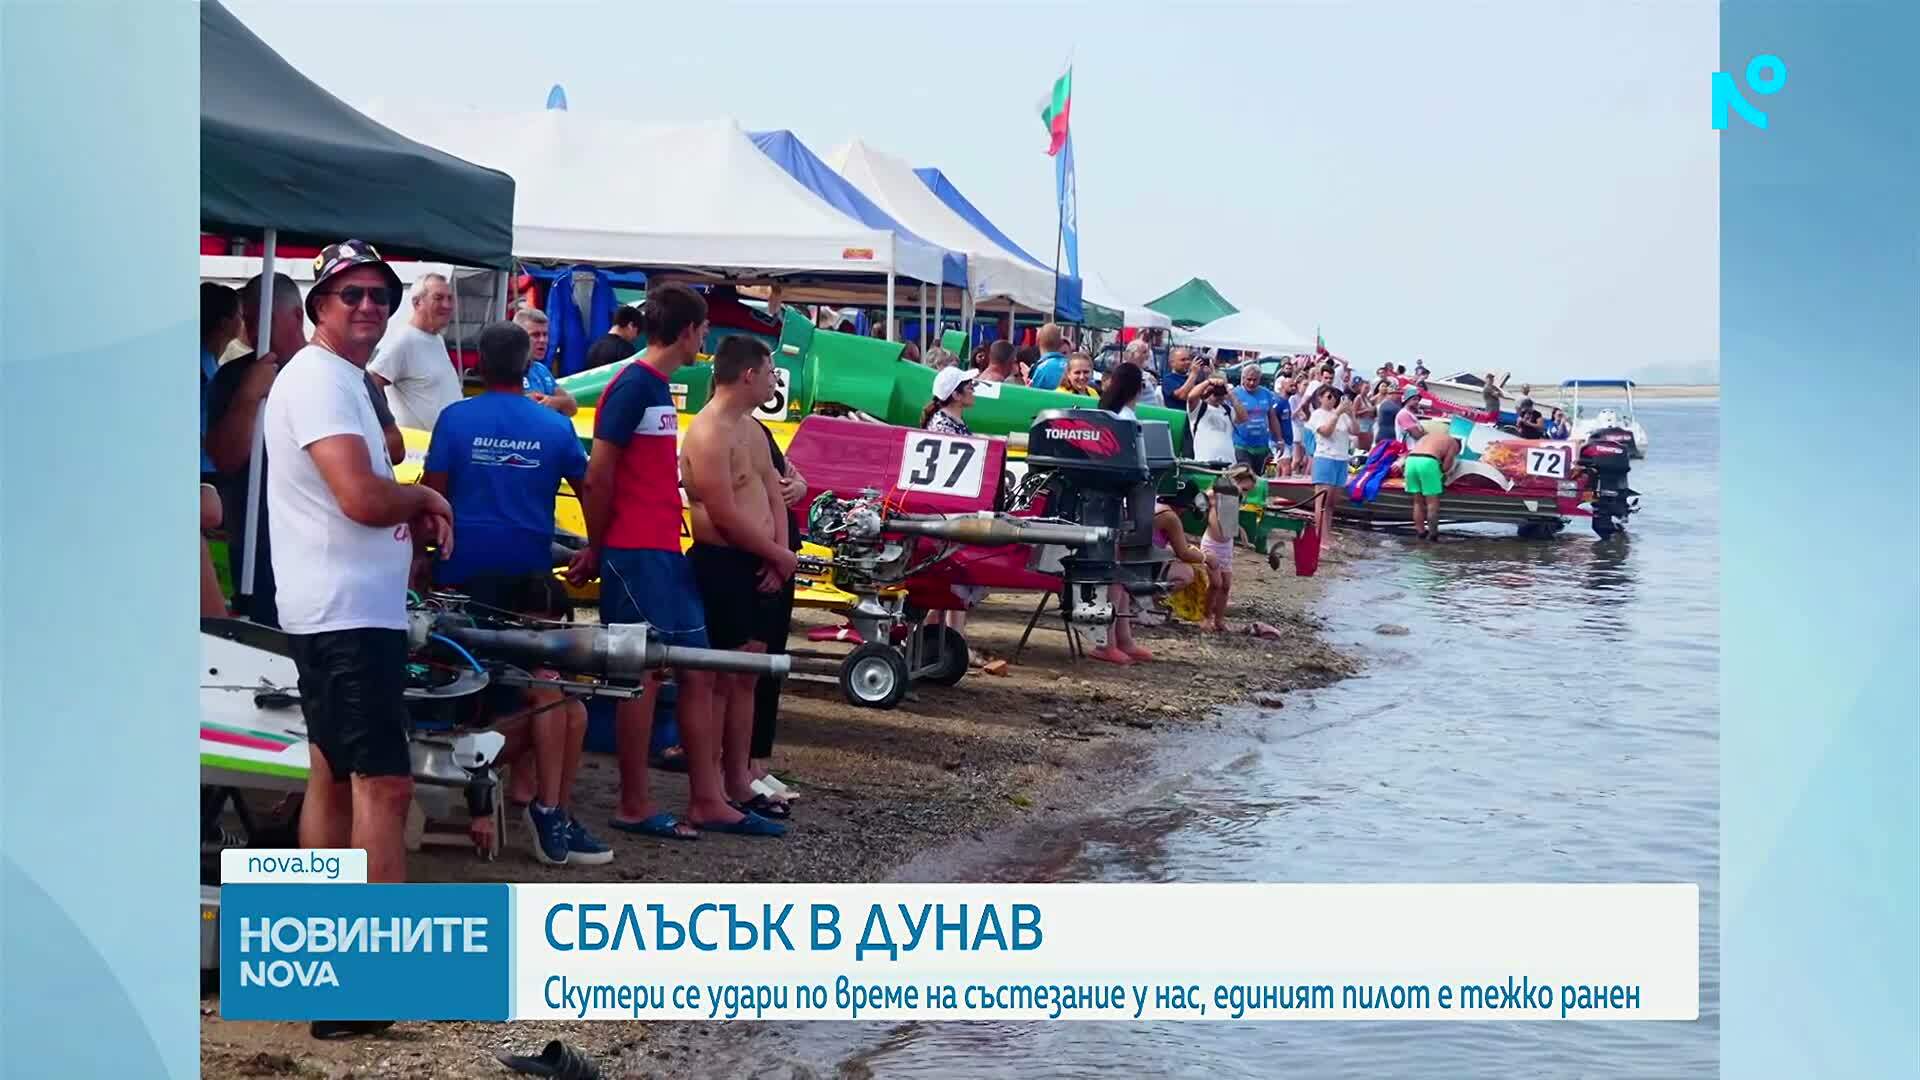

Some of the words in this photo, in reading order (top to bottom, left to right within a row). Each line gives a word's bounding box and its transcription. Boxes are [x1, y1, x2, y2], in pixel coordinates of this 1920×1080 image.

[472, 436, 541, 451] BULGARIA
[1045, 428, 1100, 441] TOHATSU
[909, 438, 976, 488] 37
[1531, 451, 1561, 475] 72
